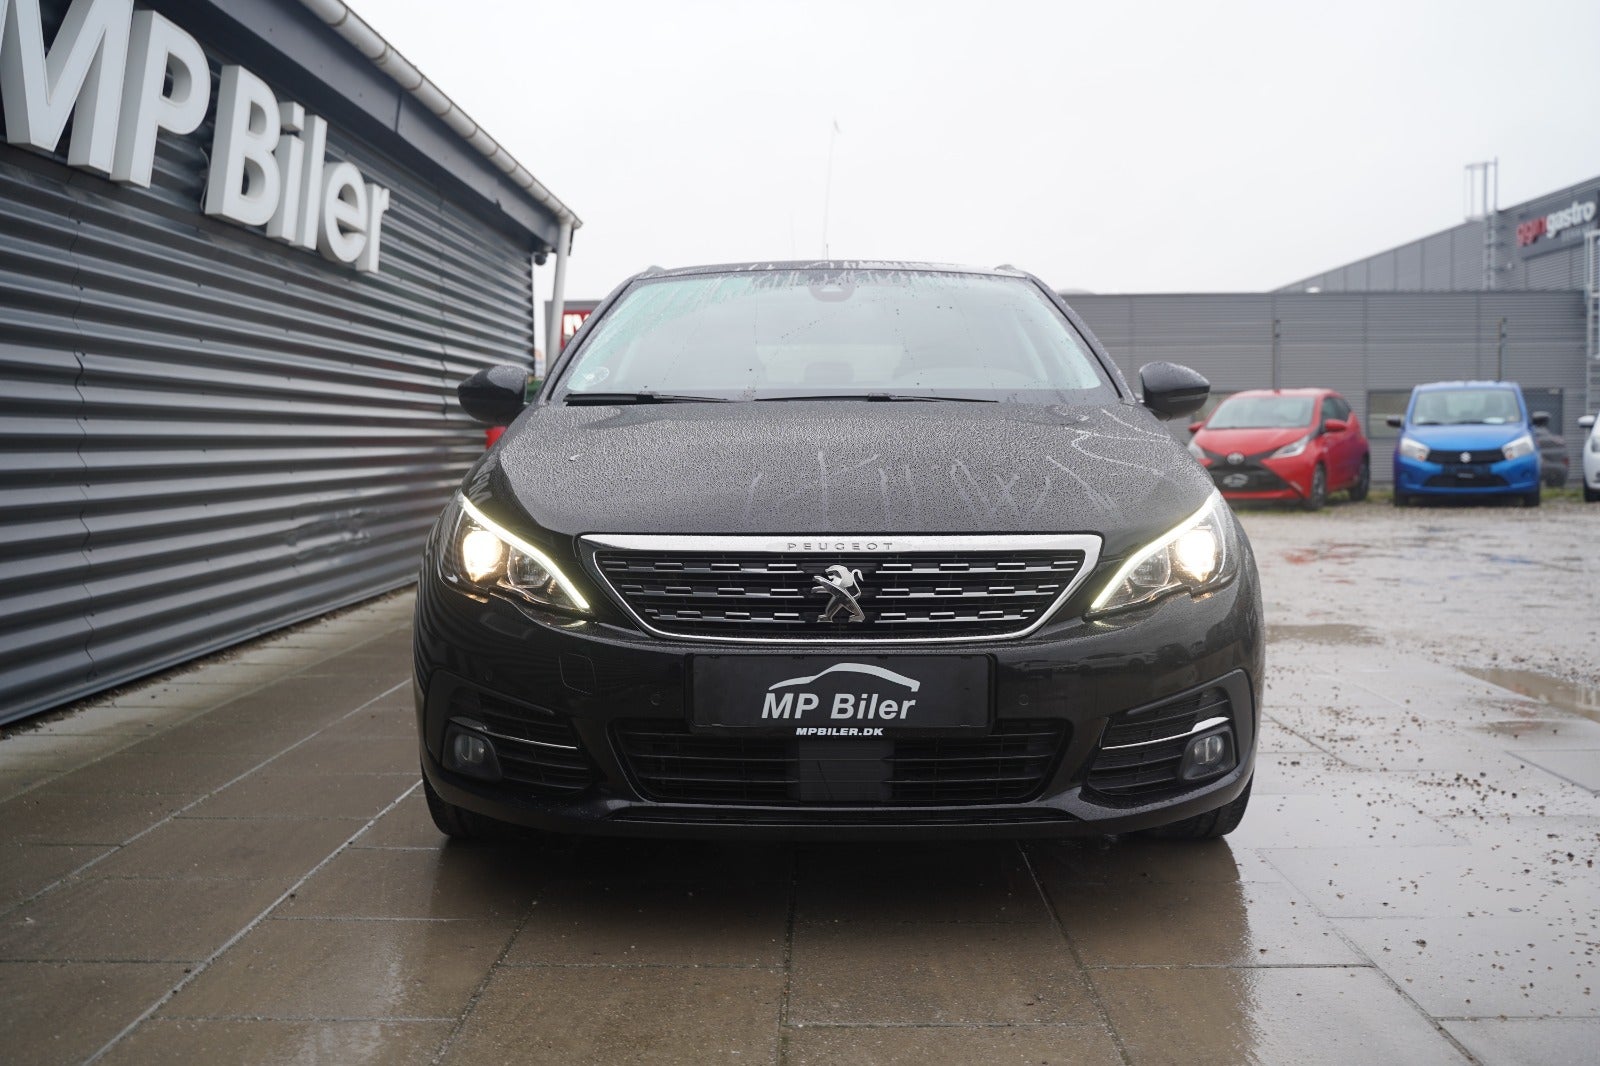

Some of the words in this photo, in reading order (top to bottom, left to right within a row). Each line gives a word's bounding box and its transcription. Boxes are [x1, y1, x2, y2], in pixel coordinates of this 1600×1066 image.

[0, 0, 211, 188] MP
[205, 65, 390, 273] Biler
[786, 542, 893, 551] PEUGEOT
[761, 692, 819, 719] MP
[830, 692, 917, 720] Biler
[795, 727, 884, 736] MPBILER.DK
